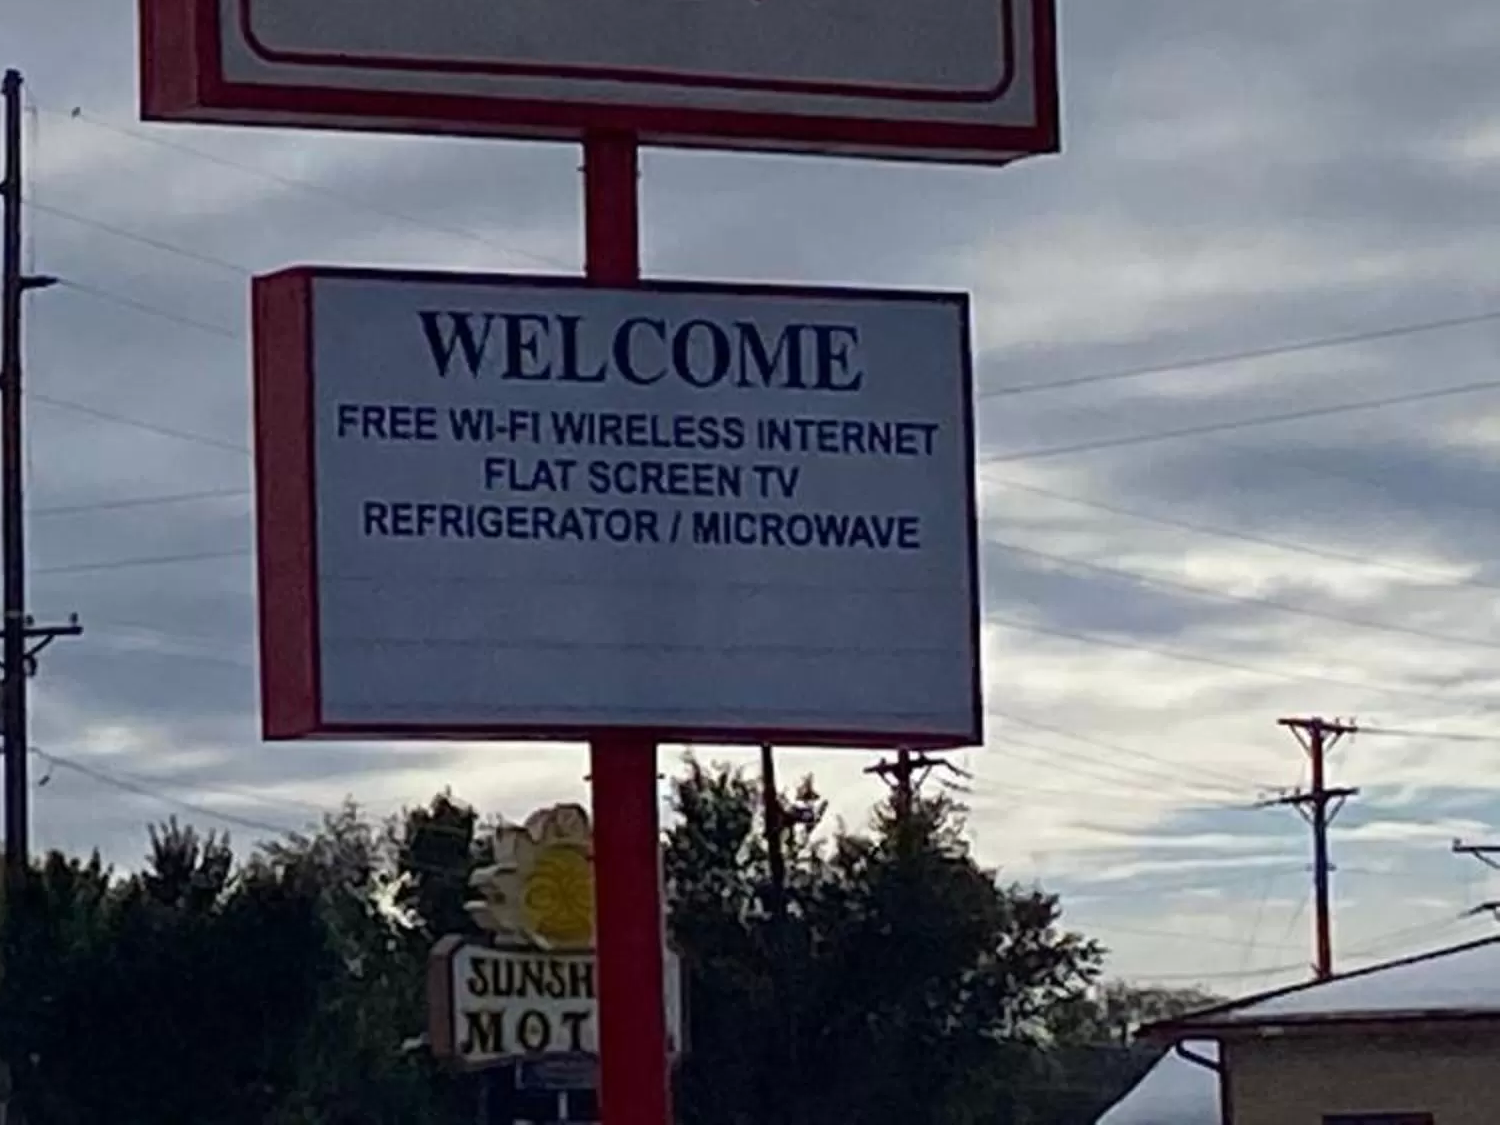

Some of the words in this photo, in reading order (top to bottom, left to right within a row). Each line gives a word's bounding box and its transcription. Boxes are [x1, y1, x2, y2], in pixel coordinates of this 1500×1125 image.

[418, 310, 864, 392] WELCOME
[337, 404, 437, 439] FREE
[449, 408, 541, 444] WI-FI
[552, 412, 745, 450] WIRELESS
[757, 418, 939, 455] INTERNET
[484, 458, 573, 493] FLAT
[588, 461, 742, 498] SCREEN
[752, 466, 800, 499] TV
[363, 502, 659, 543] REFRIGERATOR
[693, 511, 921, 550] MICROWAVE
[465, 956, 596, 999] SUNSH
[461, 1010, 591, 1055] MOT
